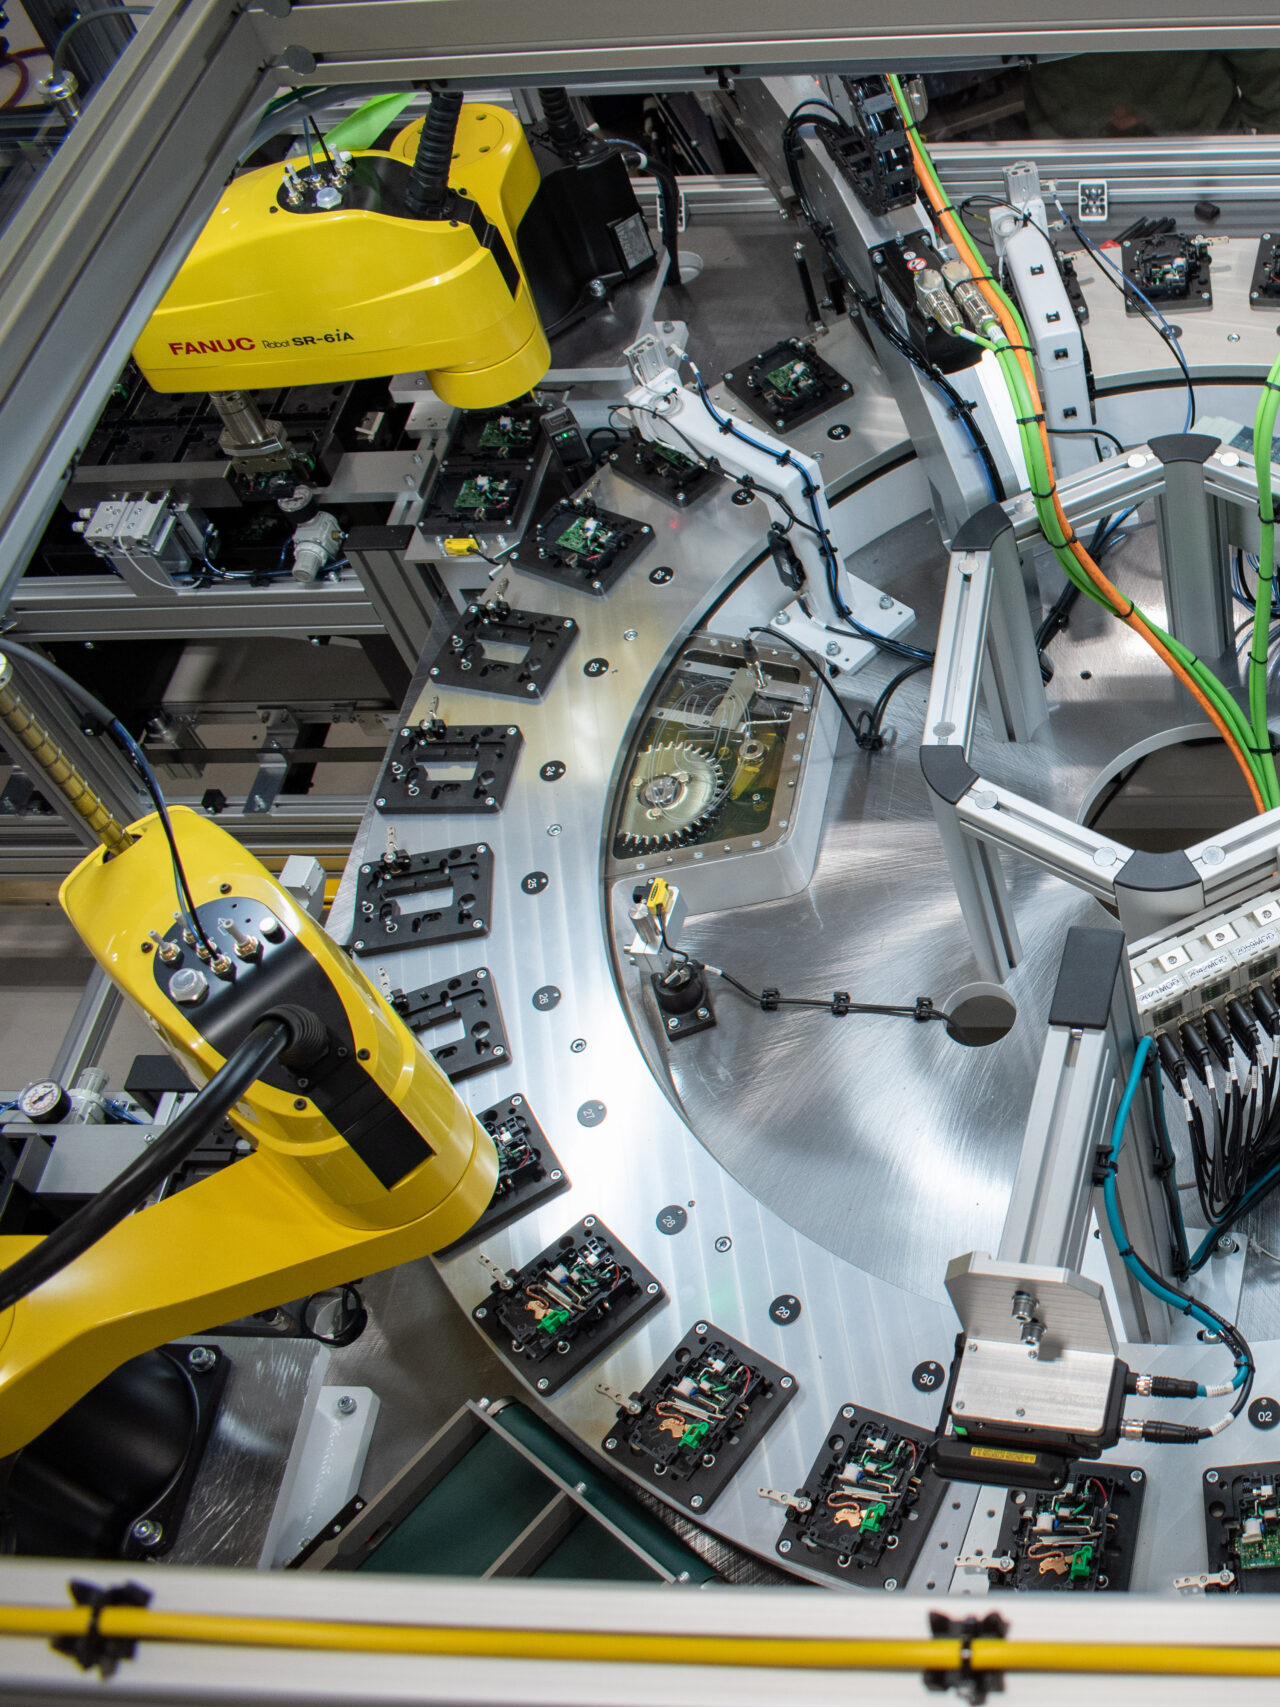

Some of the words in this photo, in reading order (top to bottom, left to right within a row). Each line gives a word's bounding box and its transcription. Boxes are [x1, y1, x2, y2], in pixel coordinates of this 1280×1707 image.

[168, 337, 256, 356] FANUC
[262, 339, 290, 349] Robot
[291, 328, 355, 347] SR-6iA
[832, 426, 844, 435] 20
[736, 491, 748, 501] 21
[653, 570, 664, 580] 22
[588, 662, 600, 673] 23
[546, 766, 556, 776] 24
[527, 878, 537, 889] 25
[539, 993, 549, 1005] 26
[582, 1109, 596, 1120] 27
[662, 1215, 676, 1228] 28
[775, 1306, 791, 1319] 29
[919, 1373, 935, 1386] 30
[1257, 1411, 1273, 1422] 02
